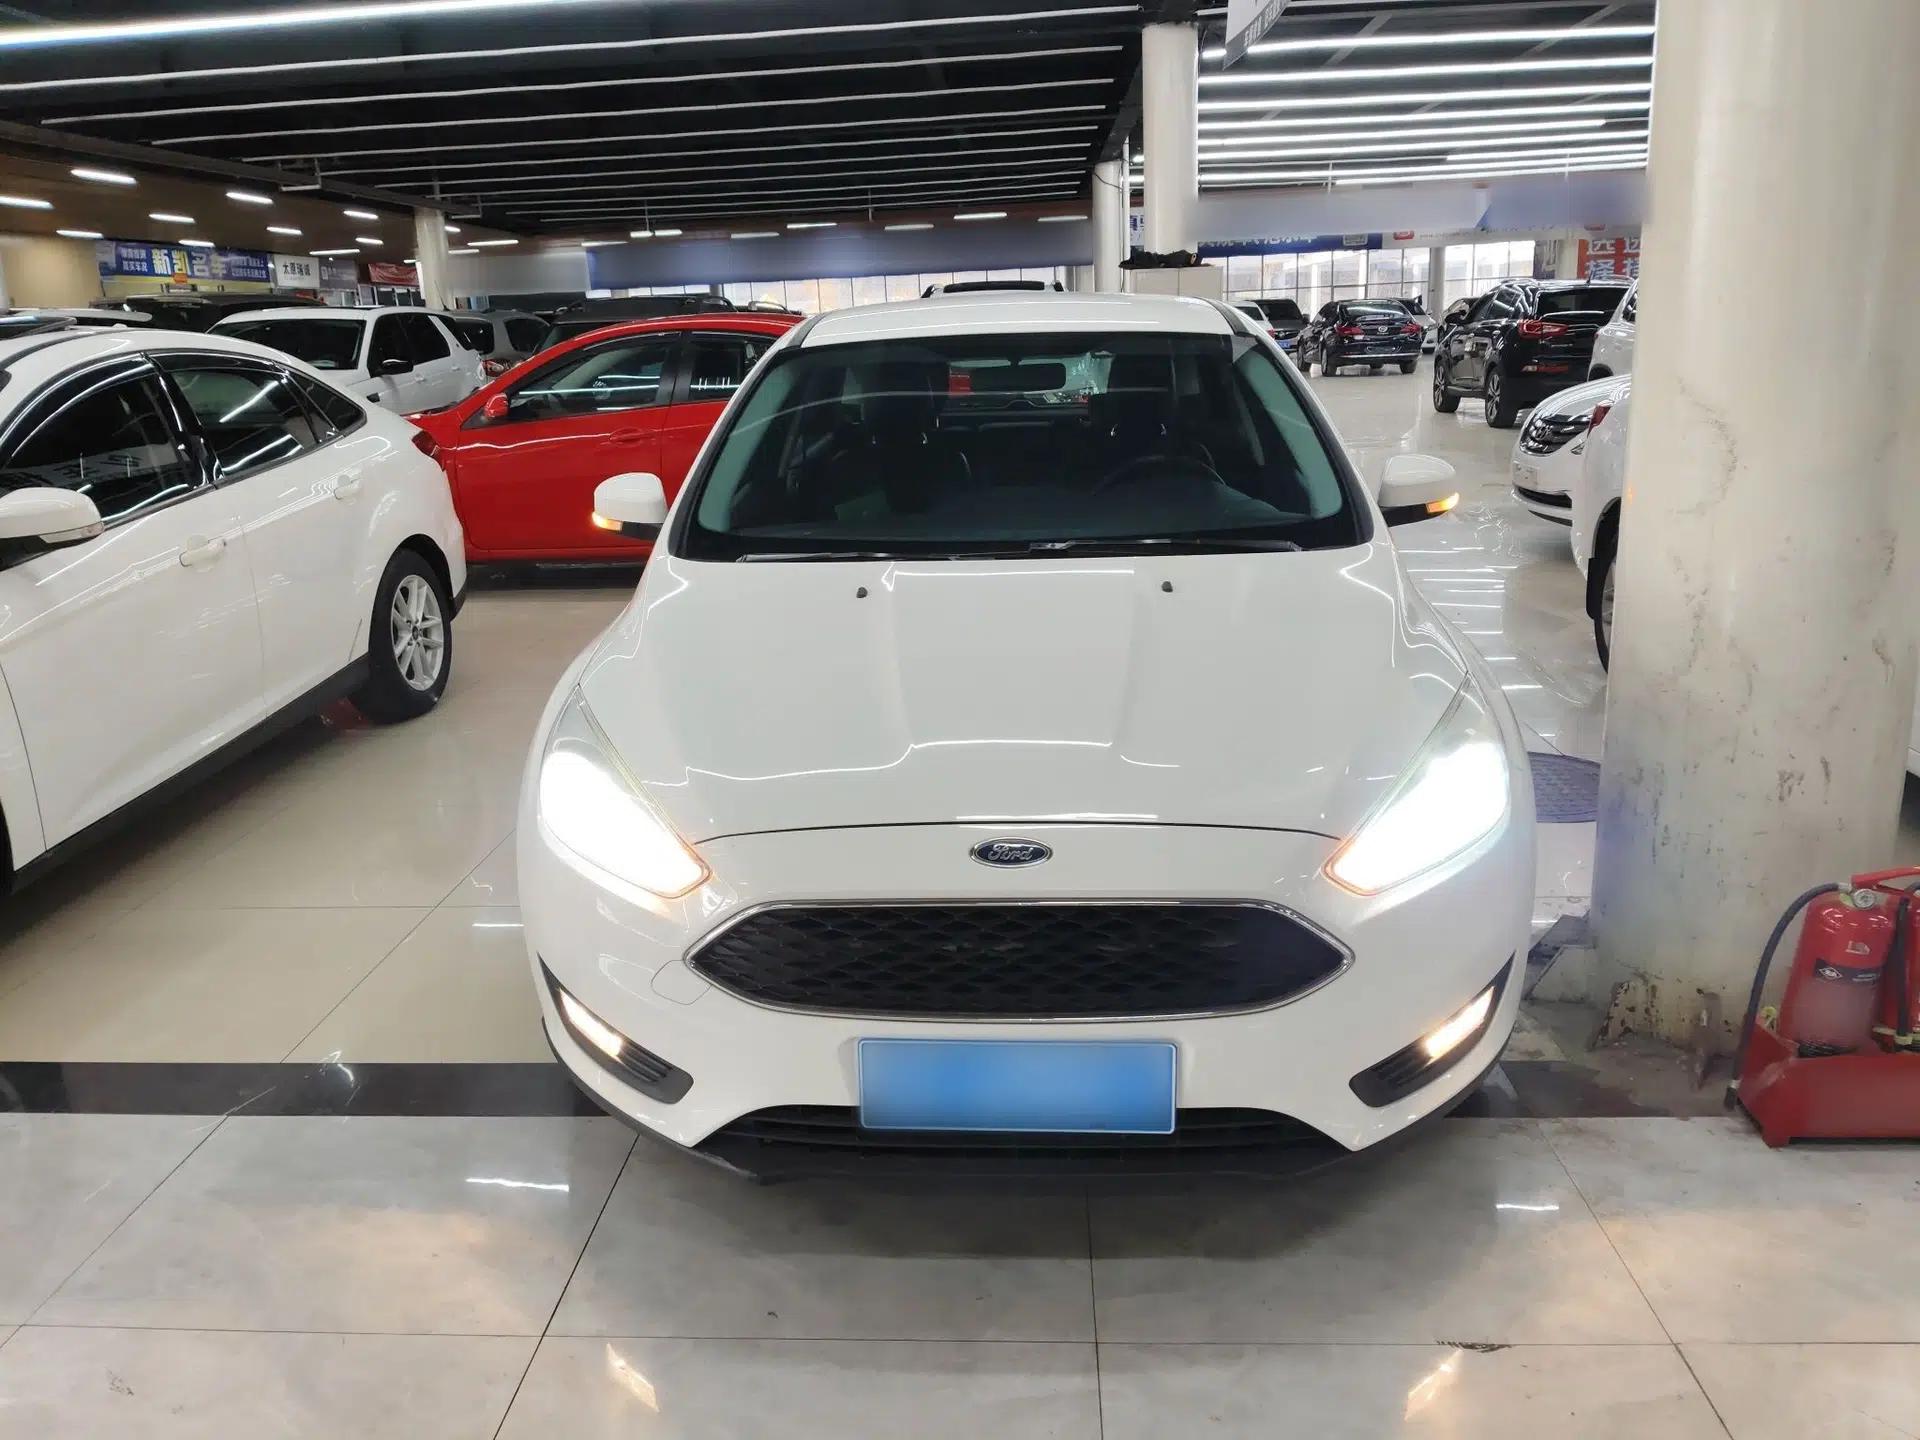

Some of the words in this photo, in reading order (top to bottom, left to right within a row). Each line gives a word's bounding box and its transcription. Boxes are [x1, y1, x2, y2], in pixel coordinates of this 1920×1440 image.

[152, 248, 227, 277] 新凯名车
[987, 843, 1035, 861] Ford
